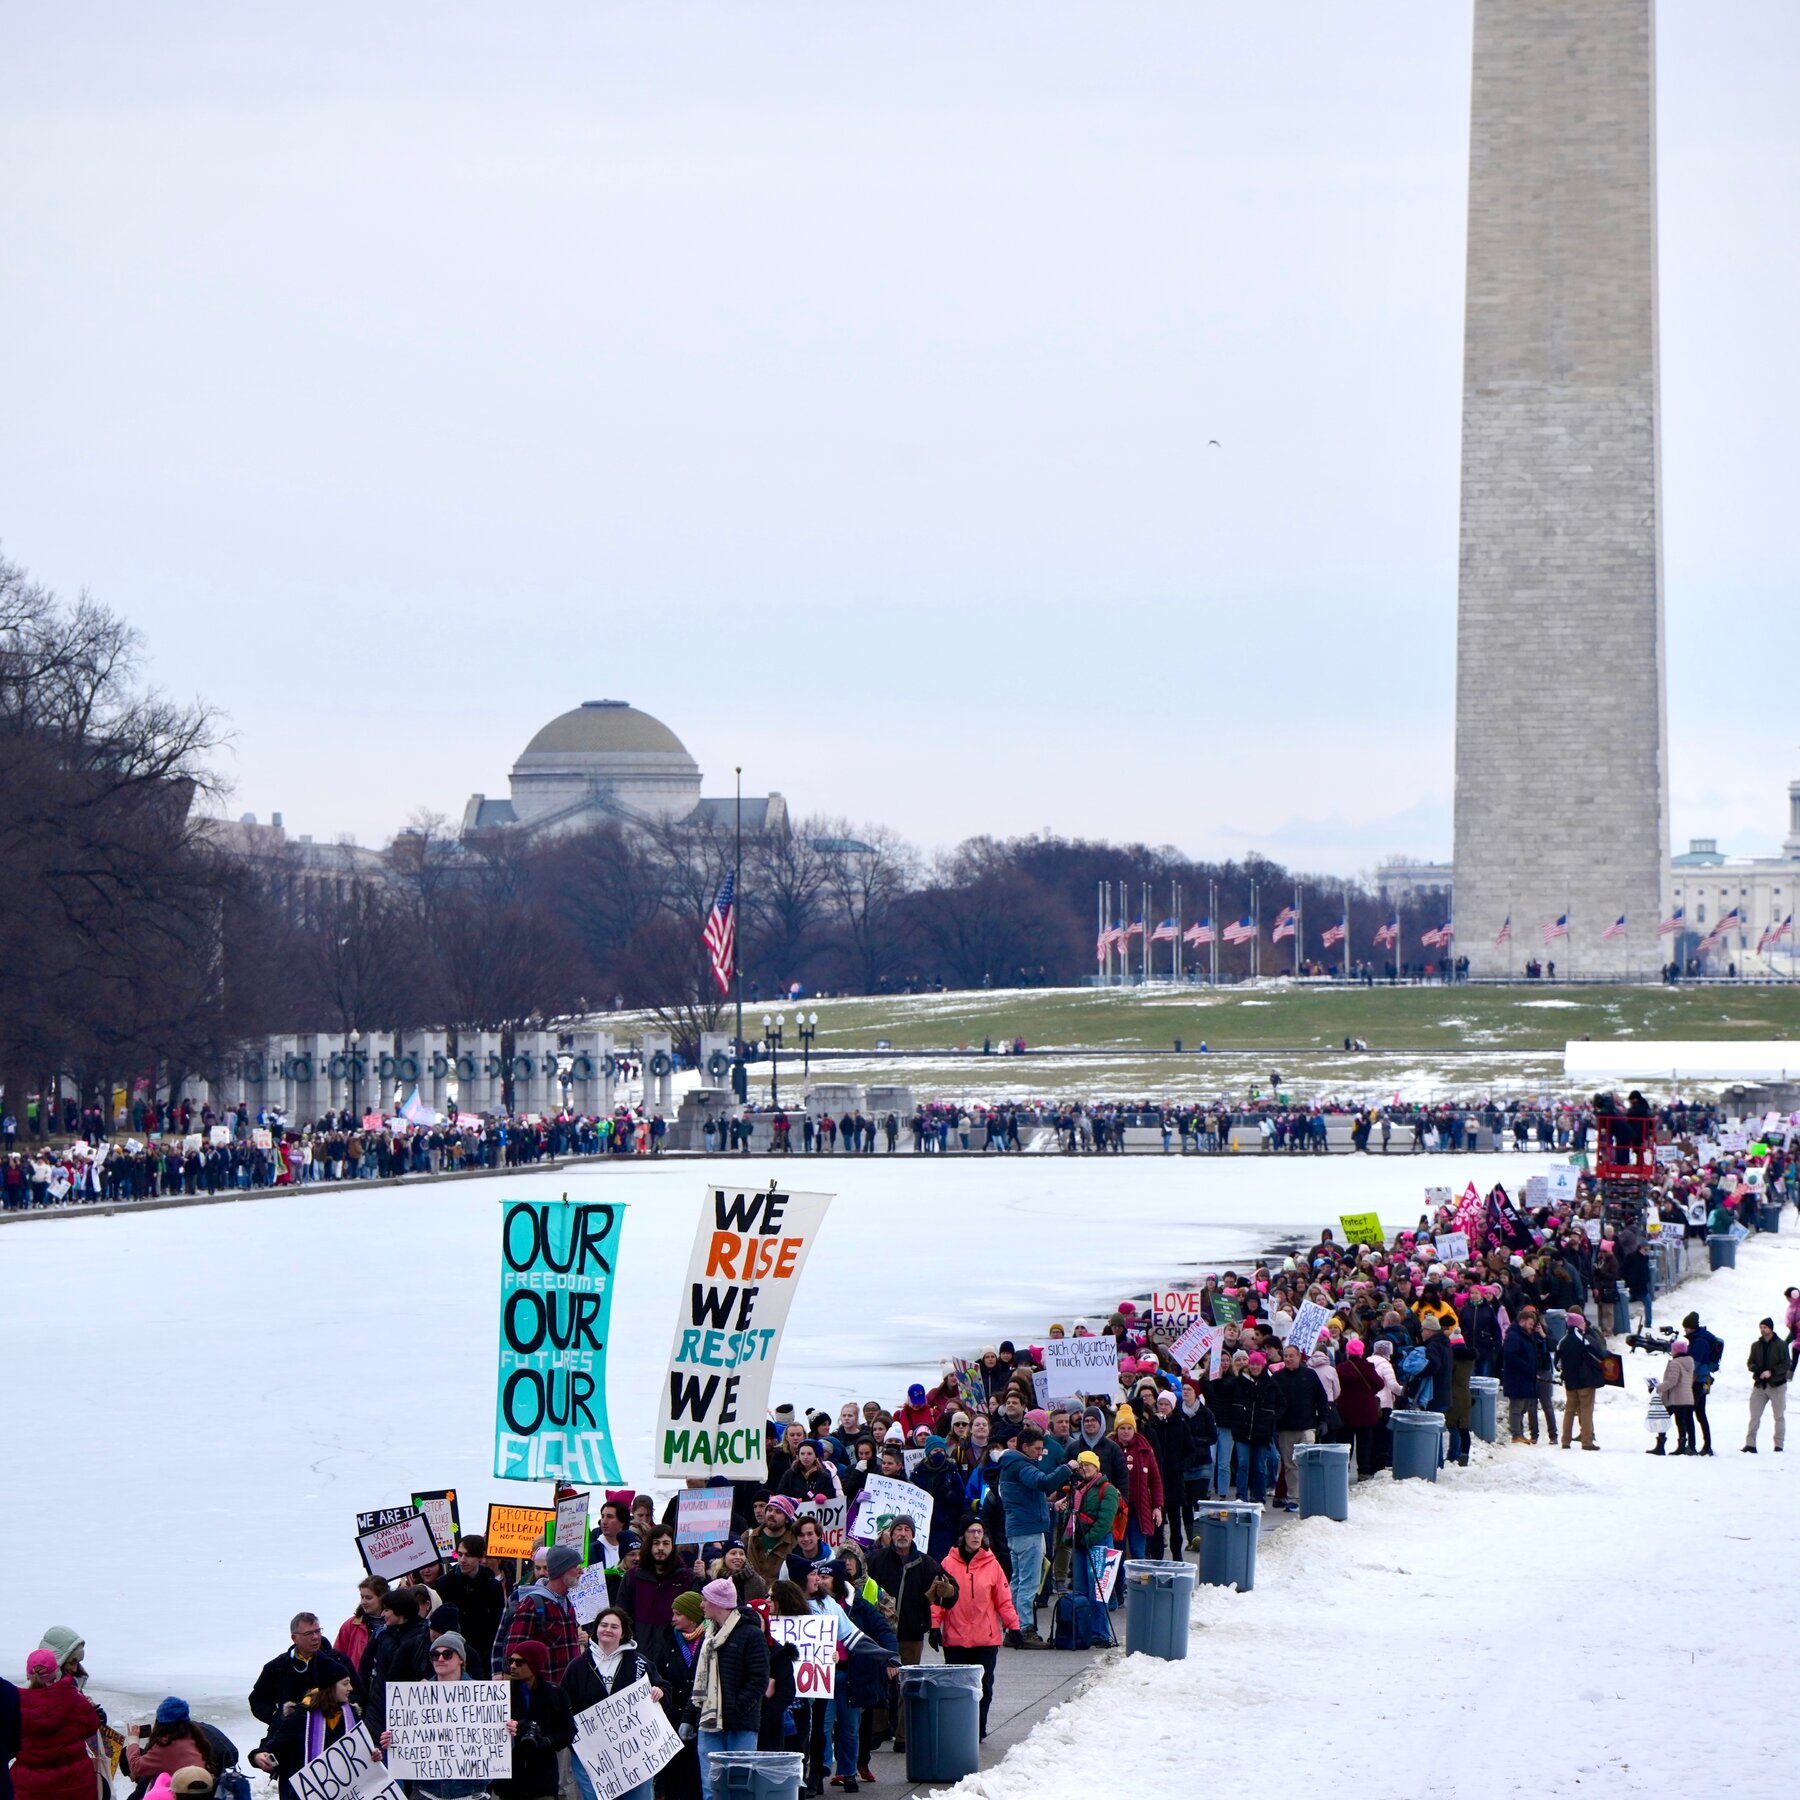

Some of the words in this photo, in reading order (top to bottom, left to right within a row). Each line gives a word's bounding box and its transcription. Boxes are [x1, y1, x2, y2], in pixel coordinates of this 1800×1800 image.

[715, 1191, 789, 1235] WE
[503, 1202, 611, 1274] OUR
[706, 1232, 803, 1280] RISE
[504, 1271, 607, 1292] FREEDOMS
[692, 1283, 759, 1331] WE
[1153, 1292, 1200, 1313] LOVE
[503, 1289, 603, 1354] OUR
[1153, 1312, 1198, 1328] EACH
[1169, 1319, 1204, 1354] IMMIGRATION
[675, 1329, 776, 1368] RESIST
[1048, 1342, 1068, 1356] such
[1184, 1333, 1214, 1368] NATION
[501, 1350, 593, 1372] FUTURES
[1056, 1357, 1080, 1367] much
[1084, 1354, 1115, 1366] WOW
[503, 1368, 597, 1436] OUR
[670, 1371, 740, 1424] WE
[663, 1428, 761, 1465] MARCH
[497, 1431, 609, 1485] FIGHT
[424, 1501, 444, 1512] STOP
[498, 1508, 551, 1521] PROTECT
[680, 1500, 708, 1511] WOMEN
[716, 1499, 732, 1508] MEN
[357, 1513, 374, 1529] WE
[379, 1508, 401, 1525] ARE
[492, 1521, 543, 1534] CHILDREN
[679, 1523, 691, 1532] ARE
[718, 1519, 730, 1529] ARE
[373, 1521, 412, 1541] SOMETHING
[489, 1546, 506, 1554] END
[784, 1619, 835, 1642] RICH
[797, 1662, 831, 1694] ON
[408, 1685, 439, 1706] MAN
[443, 1685, 471, 1703] WHO
[473, 1684, 507, 1702] FEARS
[389, 1708, 418, 1727] BEING
[421, 1708, 443, 1725] SEEN
[446, 1707, 458, 1723] AS
[462, 1704, 508, 1724] FEMININE
[579, 1714, 598, 1737] the
[595, 1700, 626, 1727] fetus
[619, 1710, 642, 1734] GAY
[390, 1729, 400, 1744] IS
[402, 1730, 410, 1744] A
[412, 1729, 436, 1743] MAN
[437, 1728, 453, 1742] WHO
[456, 1727, 481, 1744] FEARS
[482, 1728, 508, 1746] BEING
[298, 1722, 374, 1800] ABORT
[390, 1746, 431, 1760] TREATED
[438, 1745, 457, 1758] THE
[460, 1745, 483, 1759] WAY
[488, 1745, 504, 1759] HE
[411, 1759, 453, 1779] TREATS
[622, 1766, 641, 1786] for
[642, 1751, 660, 1774] its
